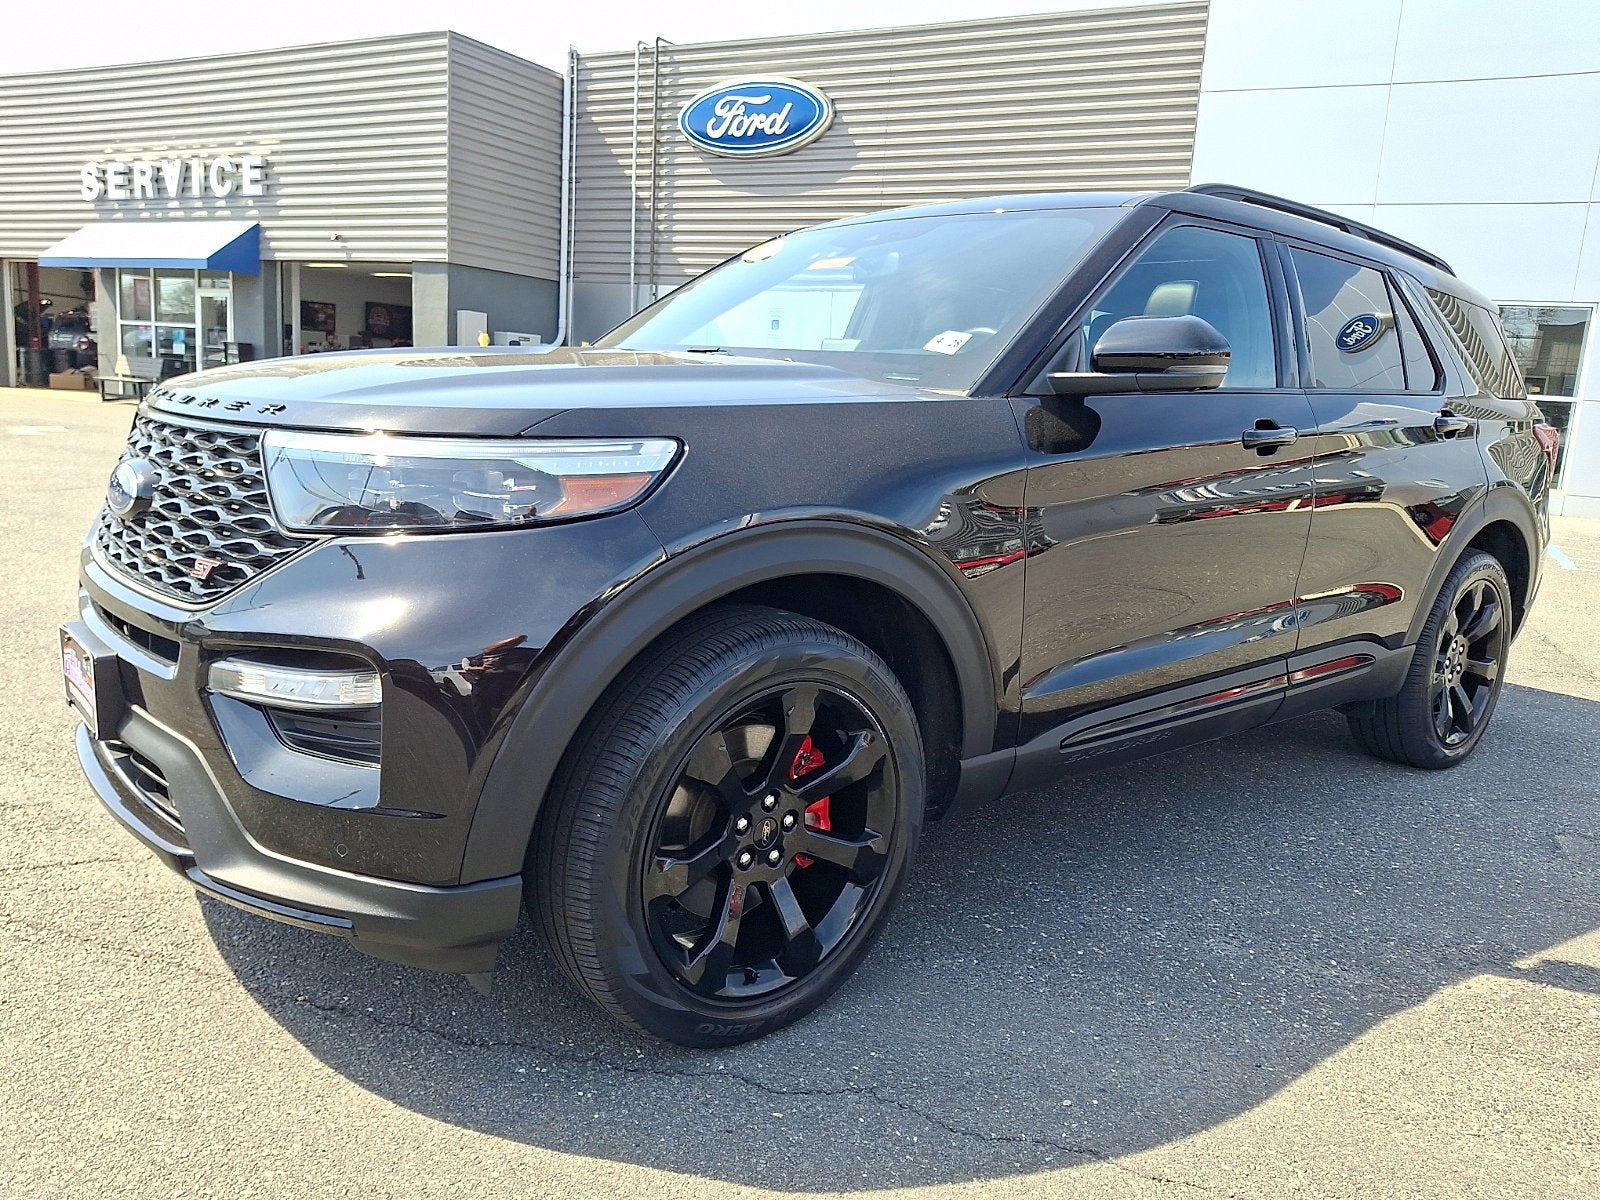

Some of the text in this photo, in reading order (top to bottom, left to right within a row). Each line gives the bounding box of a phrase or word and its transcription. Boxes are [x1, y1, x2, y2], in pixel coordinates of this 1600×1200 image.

[706, 94, 793, 139] Ford
[80, 154, 265, 201] SERVICE
[190, 556, 222, 580] ST
[695, 1020, 766, 1037] ZERO
